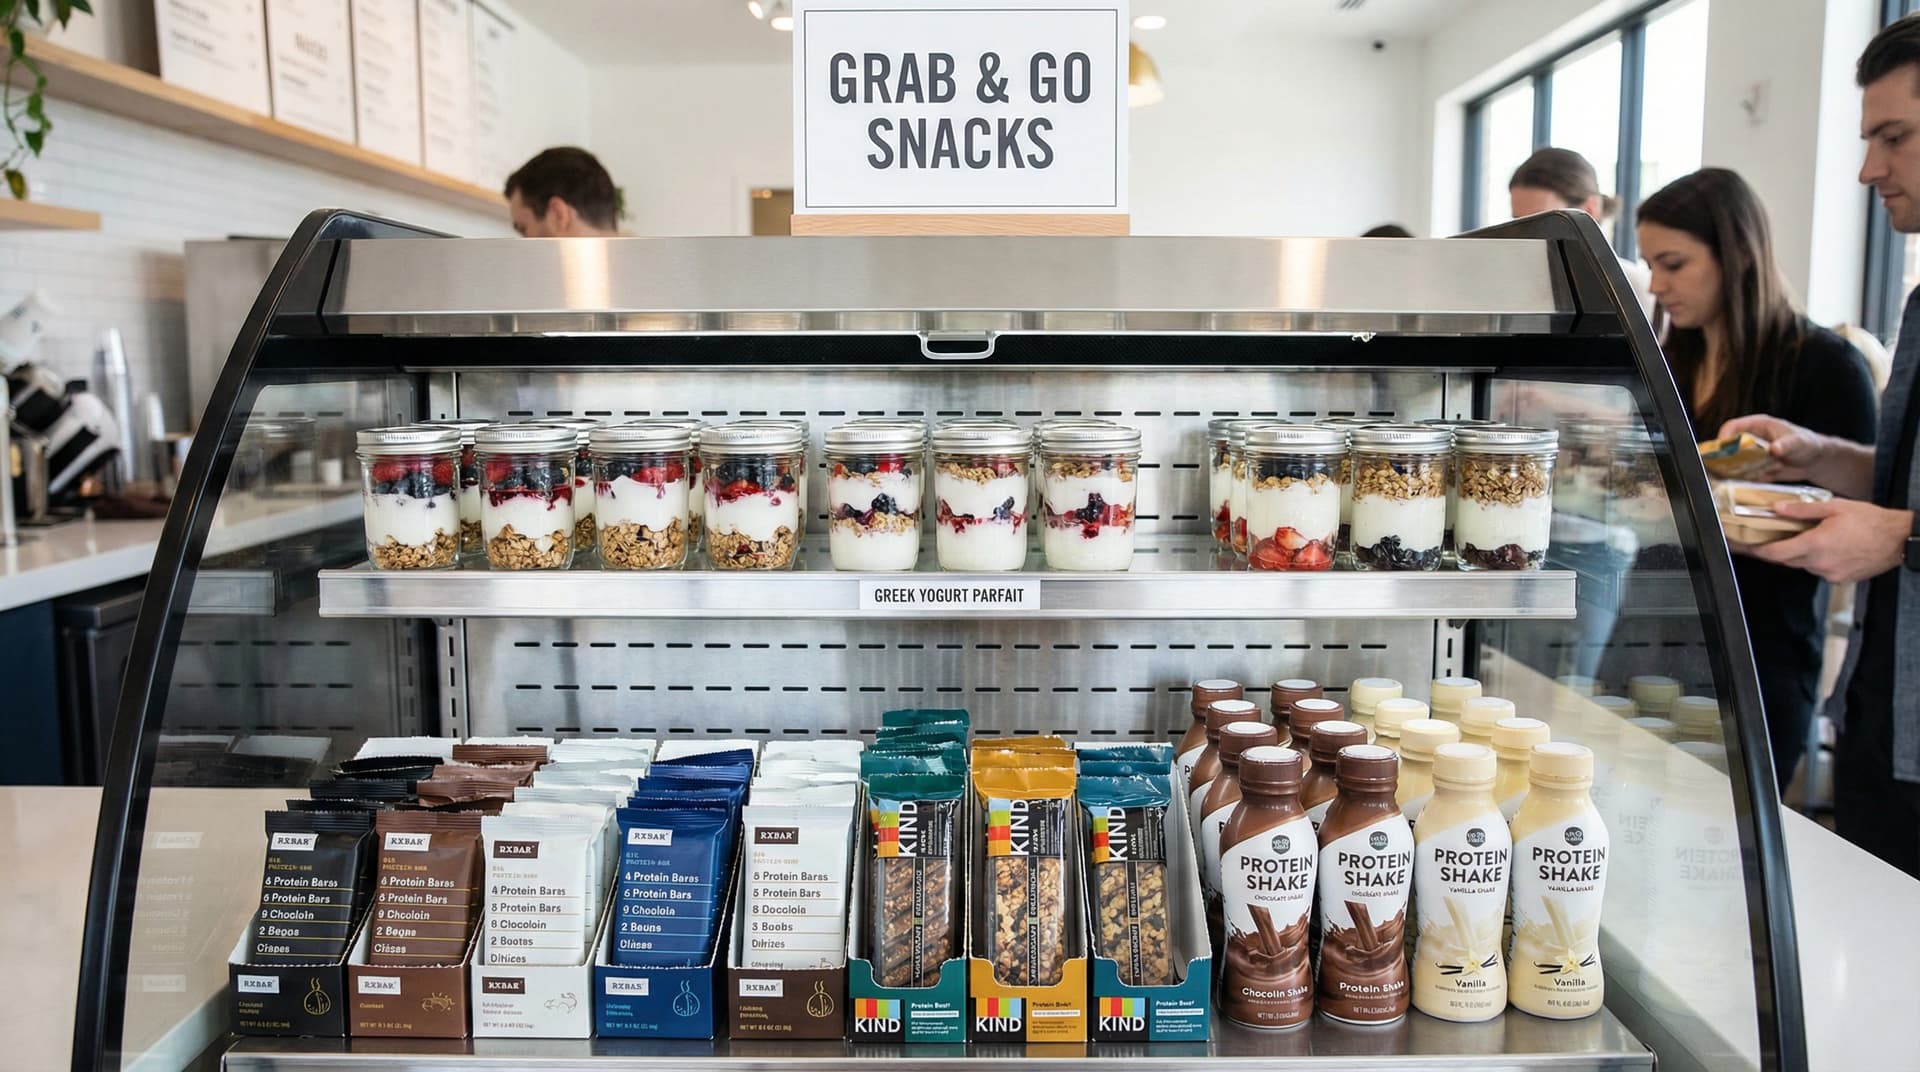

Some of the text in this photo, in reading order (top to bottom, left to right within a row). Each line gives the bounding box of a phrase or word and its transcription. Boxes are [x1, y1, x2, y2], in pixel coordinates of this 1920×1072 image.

[830, 52, 1091, 104] GRAB & GO
[866, 117, 1054, 170] SNACKS
[874, 588, 1024, 603] GREEK YOGURT PARFAIT
[898, 801, 917, 857] KIND
[1010, 800, 1029, 855] KIND
[1108, 807, 1128, 861] KIND
[760, 832, 793, 840] RXBAR
[1338, 851, 1411, 870] PROTEIN
[1435, 848, 1507, 866] PROTEIN
[1533, 847, 1606, 865] PROTEIN
[1241, 854, 1313, 874] PROTEIN
[763, 872, 798, 881] Protein
[1344, 869, 1405, 887] SHAKE
[1440, 867, 1503, 883] SHAKE
[1539, 865, 1601, 882] SHAKE
[274, 876, 309, 887] Protein
[1247, 874, 1308, 892] SHAKE
[272, 893, 306, 903] Protein
[308, 894, 330, 904] Bars
[500, 886, 537, 896] Protein
[624, 889, 692, 900] 6 Protein Bars
[763, 888, 798, 898] Protein
[800, 889, 821, 898] Bars
[426, 894, 448, 904] Bars
[501, 903, 536, 913] Protein
[539, 904, 562, 913] Bars
[623, 905, 630, 914] 9
[259, 927, 265, 935] 2
[376, 927, 383, 936] 2
[621, 923, 628, 931] 2
[491, 936, 497, 946] 2
[1456, 980, 1487, 988] Vanilla
[1554, 979, 1586, 987] Vanilla
[855, 1018, 901, 1033] KIND
[976, 1017, 1022, 1032] KIND
[1099, 1017, 1145, 1032] KIND
